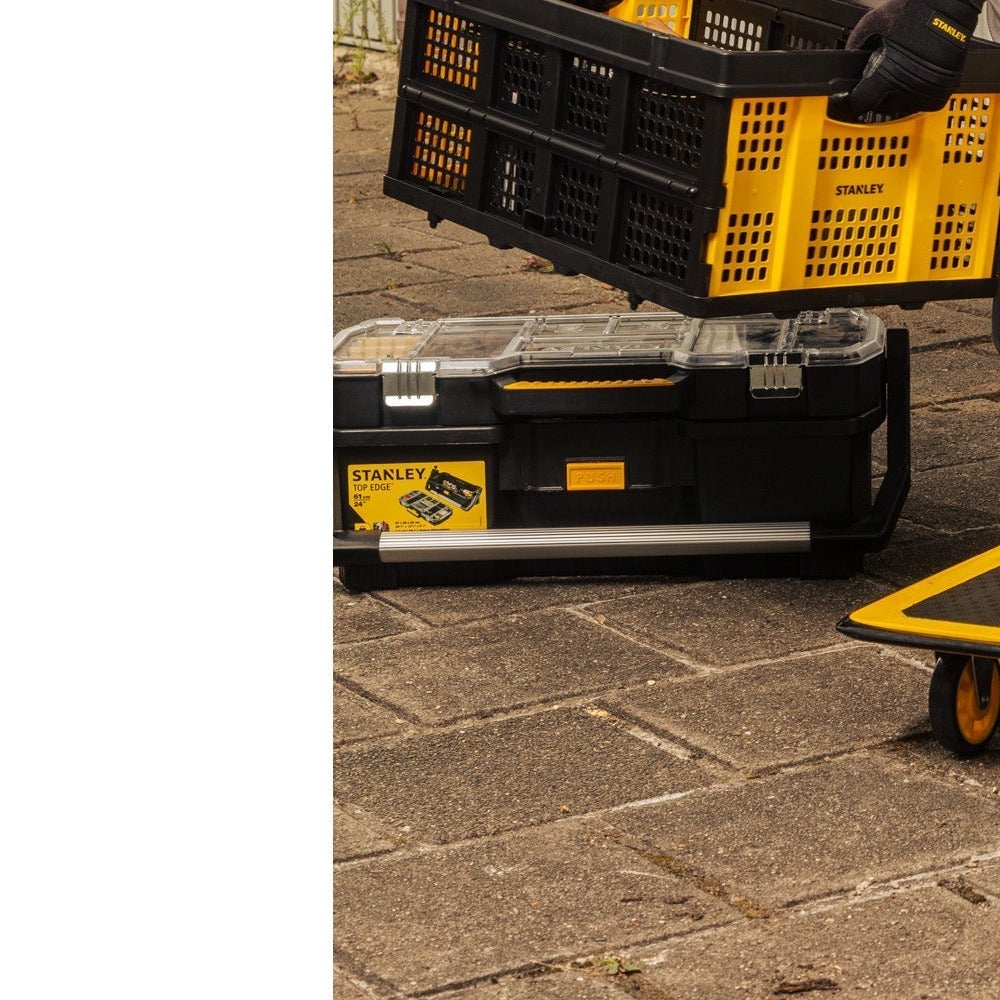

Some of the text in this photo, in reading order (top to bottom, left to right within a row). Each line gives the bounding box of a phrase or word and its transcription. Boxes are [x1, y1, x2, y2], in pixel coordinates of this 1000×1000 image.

[932, 17, 967, 43] STANLEY
[835, 183, 884, 196] STANLEY
[352, 468, 426, 482] STANLEY
[353, 483, 368, 492] TOP
